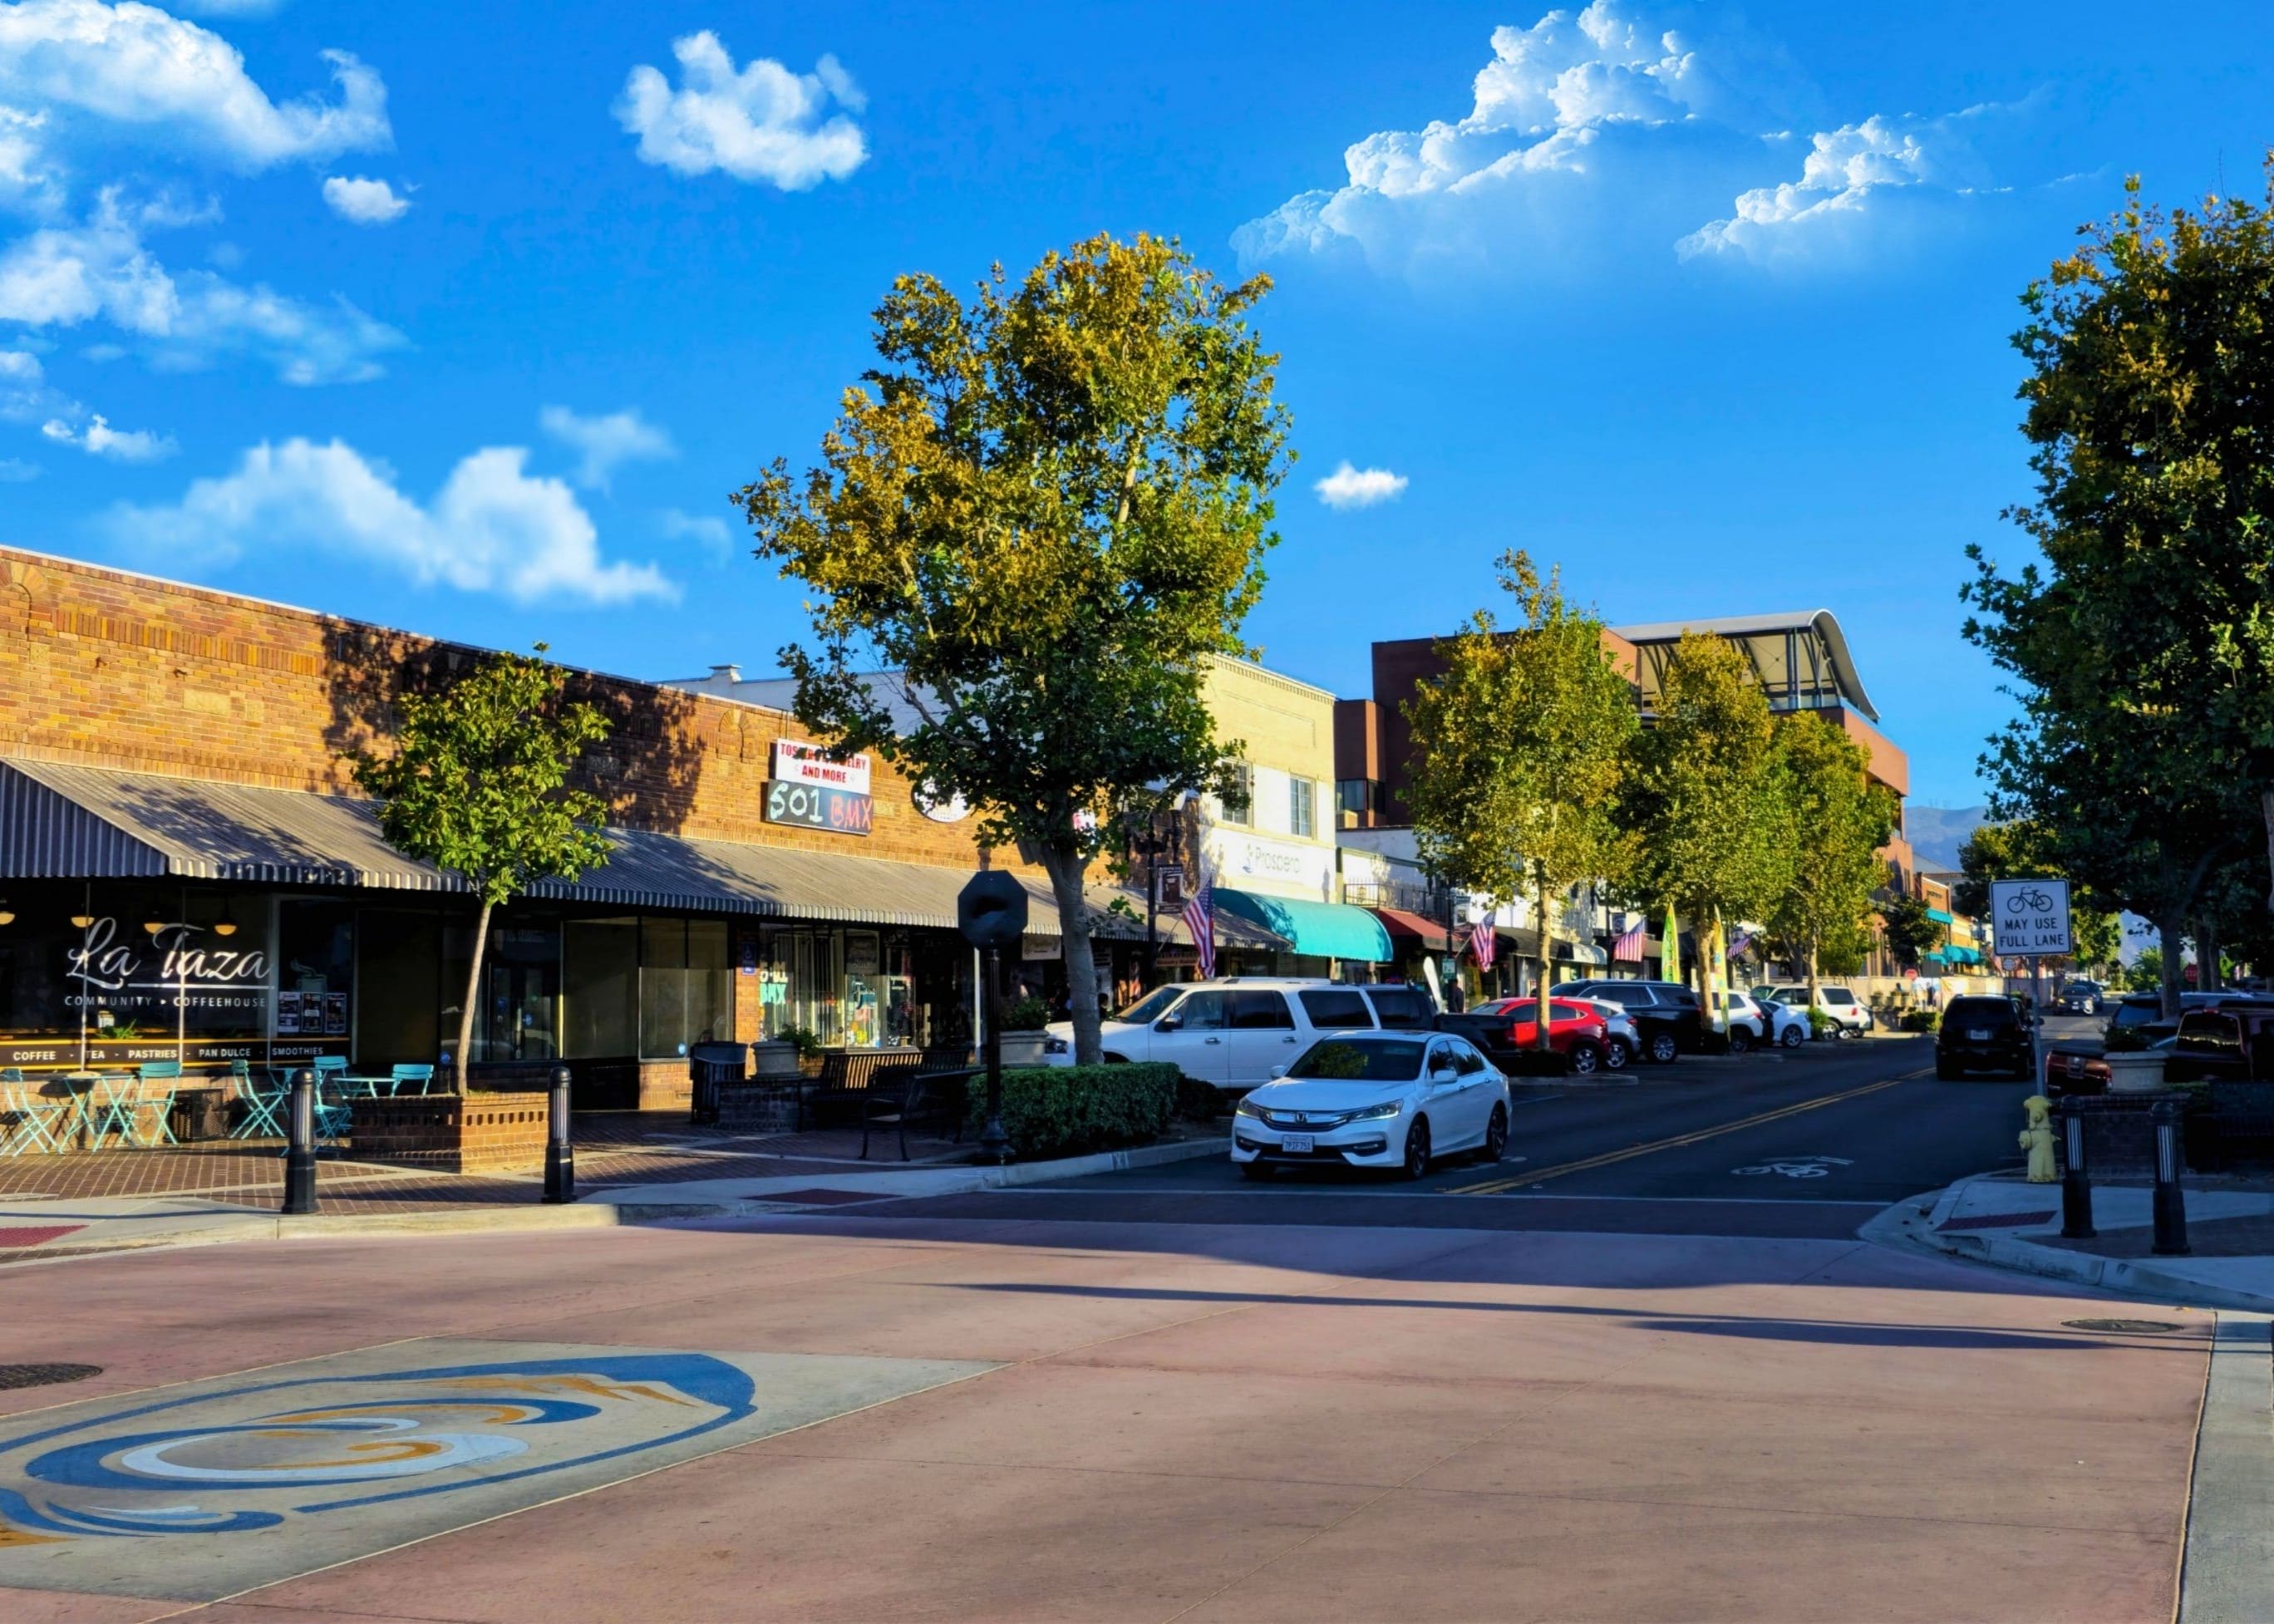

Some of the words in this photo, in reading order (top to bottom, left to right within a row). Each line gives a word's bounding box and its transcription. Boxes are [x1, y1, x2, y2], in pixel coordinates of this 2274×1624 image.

[802, 765, 820, 779] AND
[822, 769, 846, 783] MORE
[830, 795, 873, 830] BMX
[2005, 918, 2028, 930] MAY
[2035, 918, 2057, 929] USE
[2000, 936, 2029, 947] FULL
[2035, 934, 2065, 946] LANE
[66, 917, 141, 990] La
[153, 923, 274, 981] Taza
[65, 997, 151, 1008] COMMUNITY
[173, 997, 267, 1008] COFFEEHOUSE
[12, 1051, 57, 1061] COFFEE
[86, 1050, 106, 1059] TEA
[128, 1049, 178, 1059] PASTRIES
[199, 1049, 219, 1058] PAN
[220, 1048, 251, 1057] DULCE
[272, 1046, 324, 1056] SMOOTHIES
